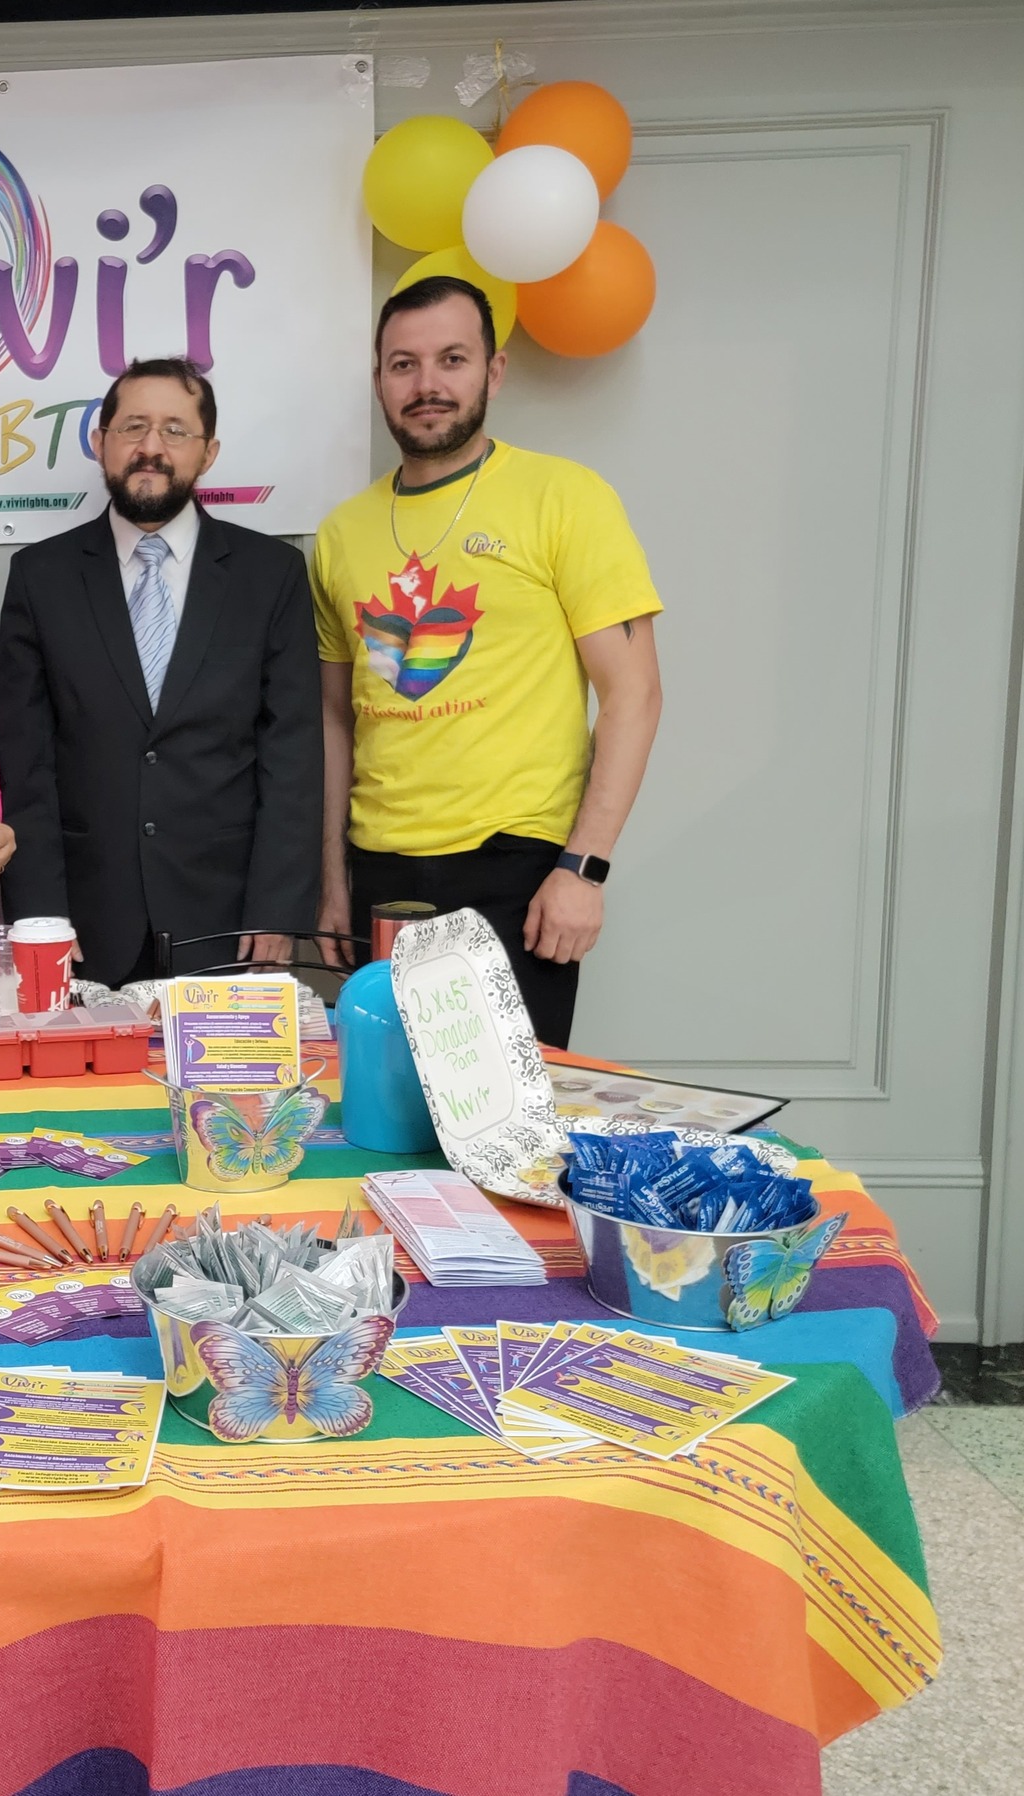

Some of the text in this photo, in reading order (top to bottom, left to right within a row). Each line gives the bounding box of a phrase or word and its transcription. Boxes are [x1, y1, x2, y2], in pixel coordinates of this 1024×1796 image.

[186, 988, 219, 1003] Vivi'r
[410, 988, 432, 1023] 2
[444, 1049, 479, 1073] Para
[652, 1162, 691, 1190] IFESTYLES
[4, 1377, 49, 1390] Vivi'r
